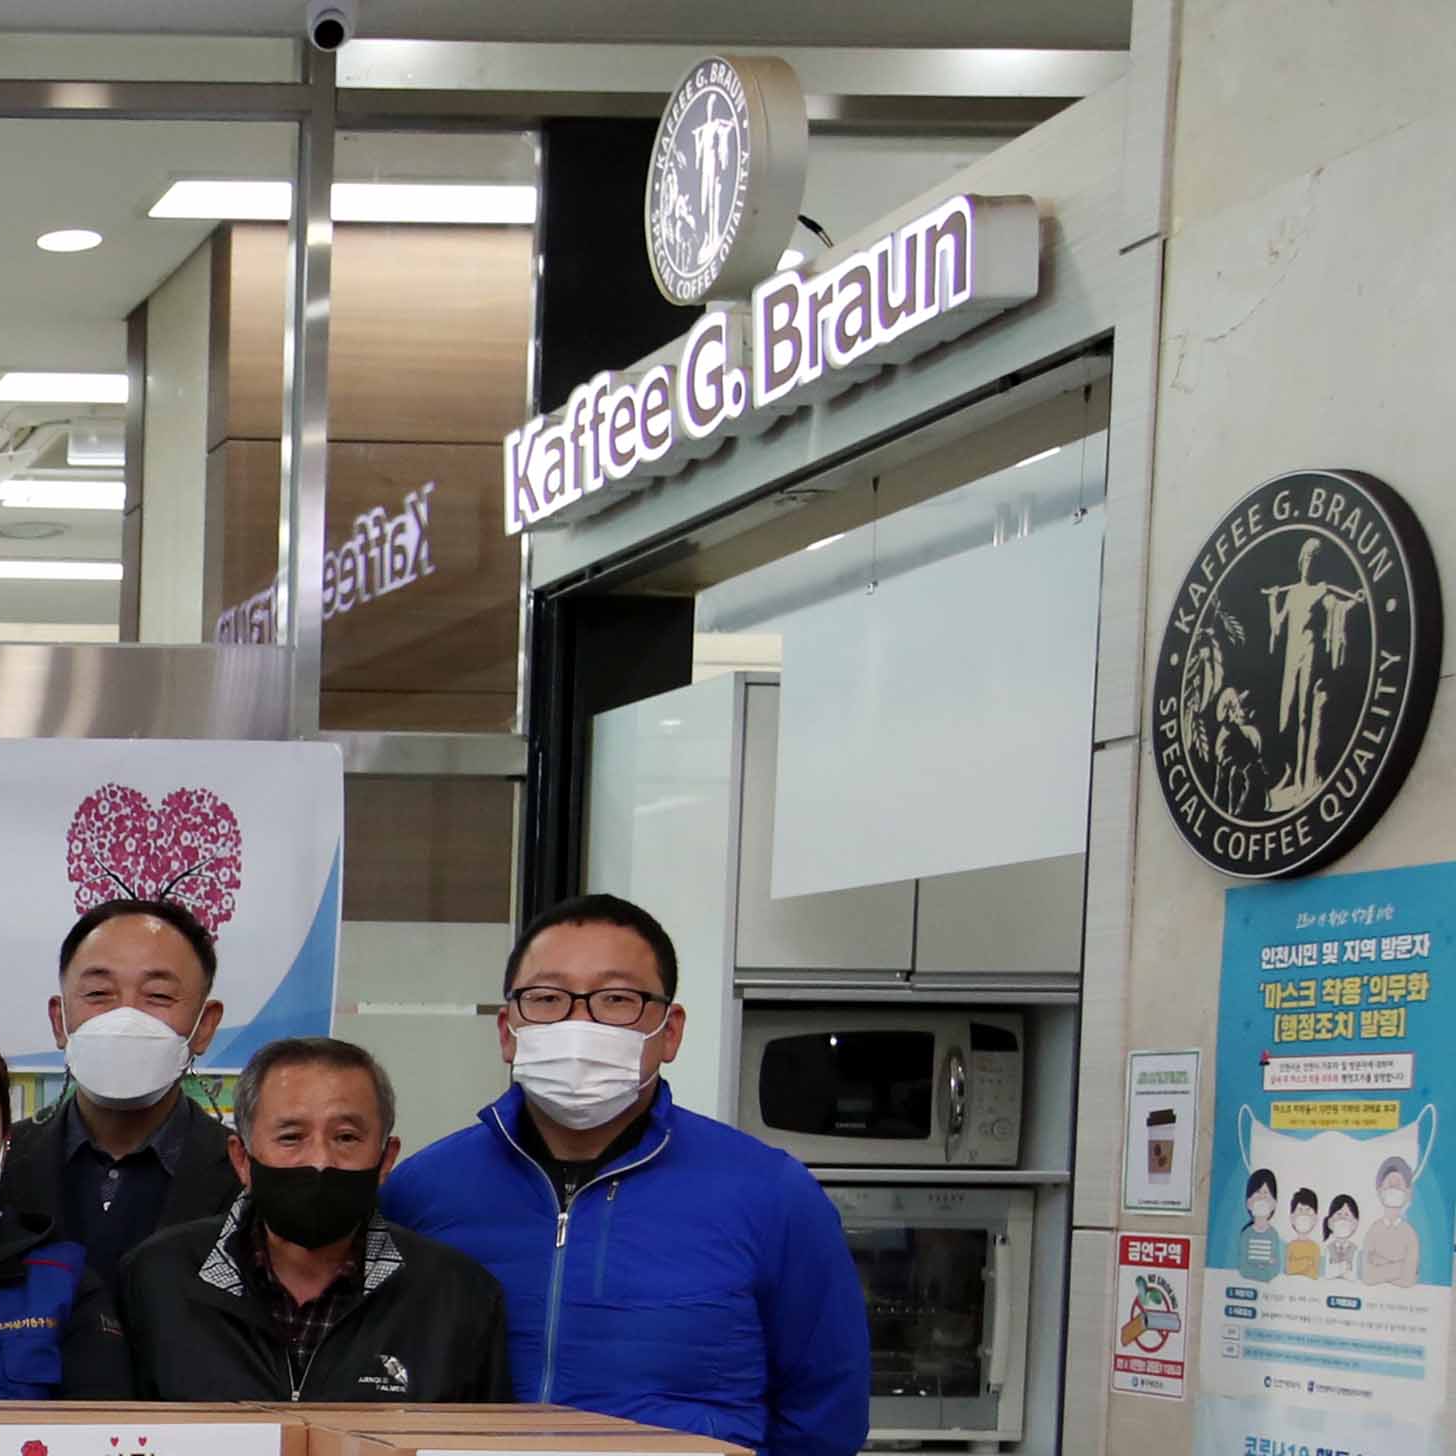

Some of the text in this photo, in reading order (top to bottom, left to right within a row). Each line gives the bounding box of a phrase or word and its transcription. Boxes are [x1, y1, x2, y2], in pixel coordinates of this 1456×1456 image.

[656, 80, 694, 170] KAFFEE
[710, 63, 745, 112] BRAUN
[508, 205, 972, 530] Kaffee G. Braun
[1174, 487, 1393, 634] KAFFEE G. BRAUN
[1159, 650, 1403, 861] SPECIAL COFFEE QUALITY
[1343, 939, 1376, 962] 지역
[1381, 933, 1431, 960] 방문자
[1128, 1241, 1182, 1264] 금연구역
